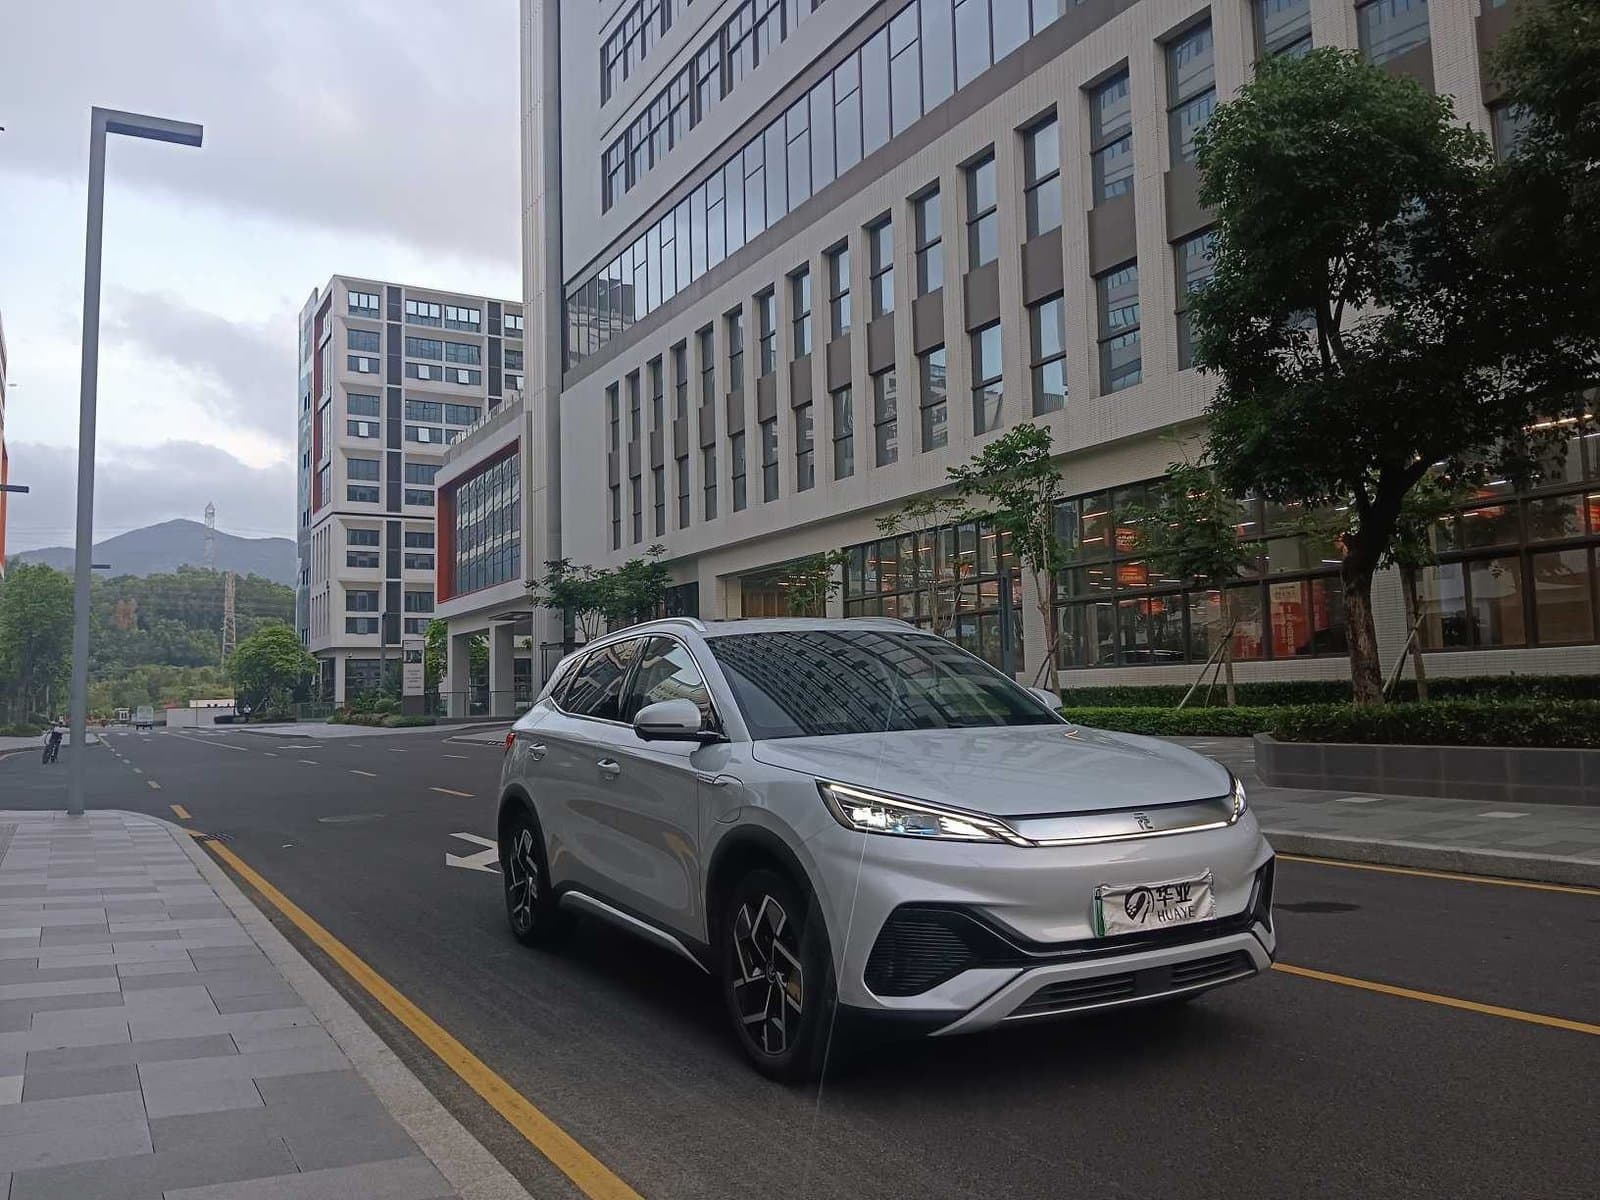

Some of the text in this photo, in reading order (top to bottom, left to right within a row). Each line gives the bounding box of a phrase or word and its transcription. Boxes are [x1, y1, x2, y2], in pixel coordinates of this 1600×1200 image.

[1134, 812, 1154, 830] 元
[1156, 881, 1193, 907] 华业
[1157, 905, 1196, 922] HUAYE
